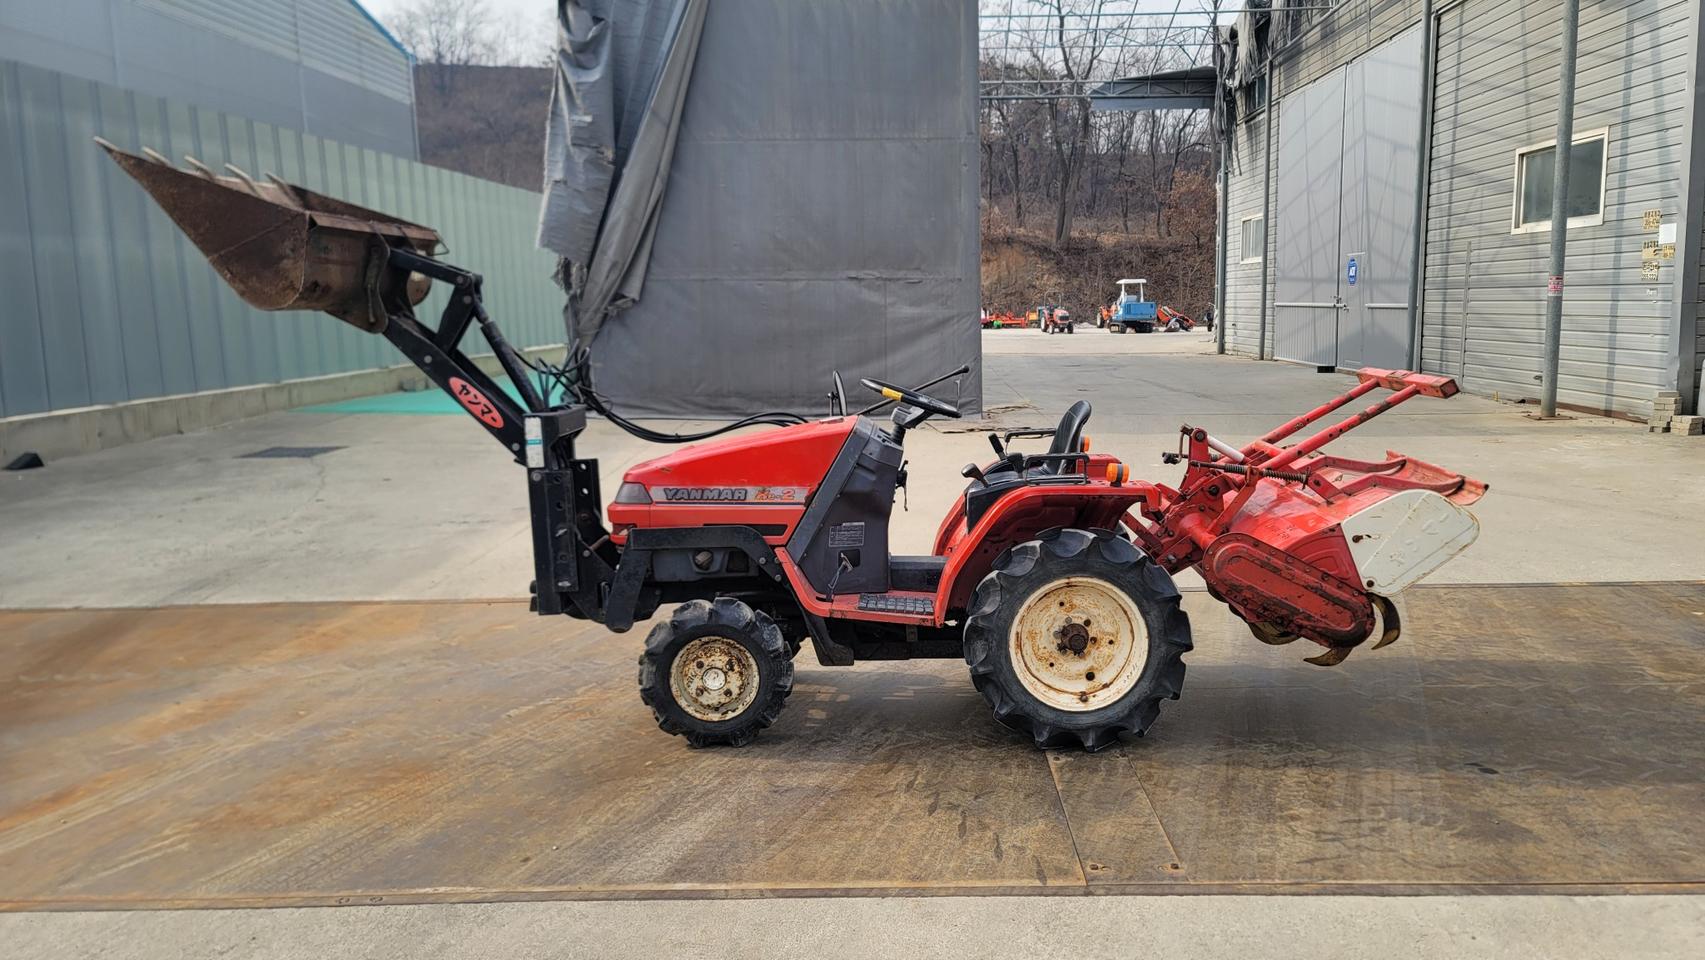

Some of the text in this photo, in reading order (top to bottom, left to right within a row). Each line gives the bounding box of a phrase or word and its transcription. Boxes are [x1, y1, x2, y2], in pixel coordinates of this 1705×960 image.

[459, 384, 497, 422] ヤンマー
[664, 487, 747, 501] YANMAR
